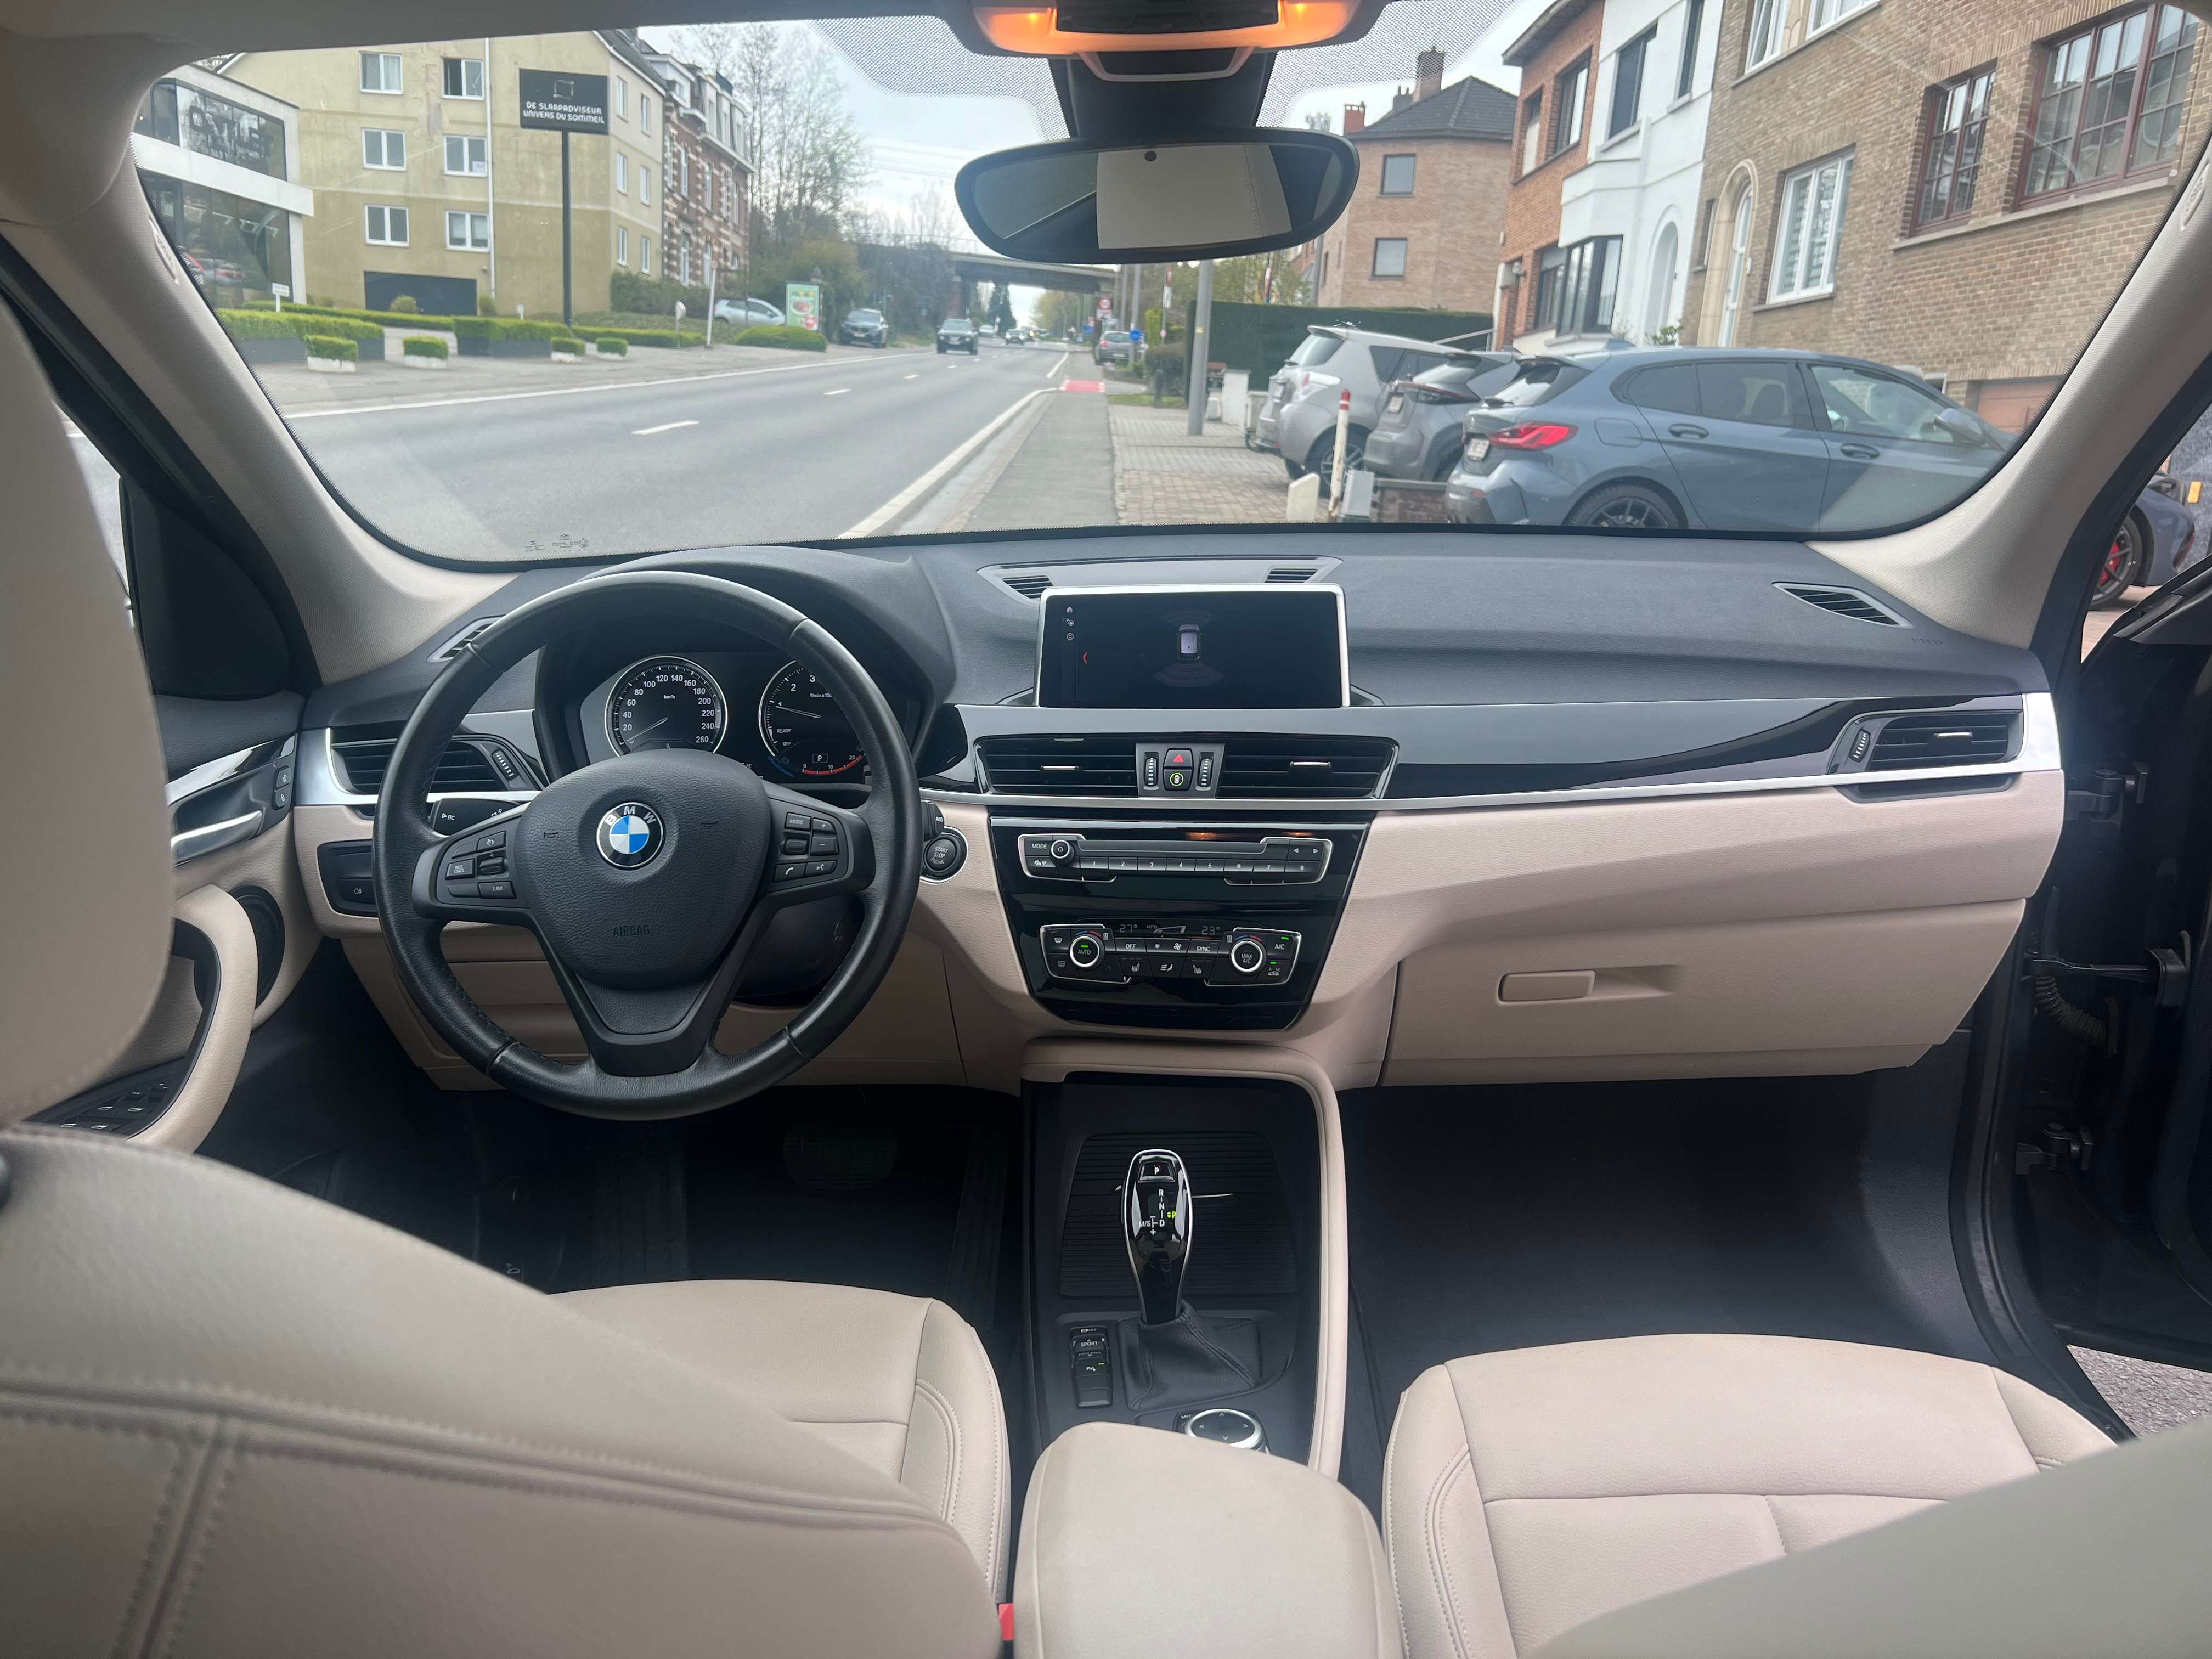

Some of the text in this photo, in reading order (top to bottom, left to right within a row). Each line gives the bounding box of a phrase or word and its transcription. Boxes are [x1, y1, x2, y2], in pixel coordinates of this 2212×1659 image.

[538, 103, 602, 115] SLAAPADVISEUR
[523, 110, 605, 123] UNIVERS DU SOMMEIL
[809, 674, 815, 682] 3
[791, 684, 797, 692] 2
[605, 805, 657, 826] BMW
[613, 925, 650, 937] AIRBAG
